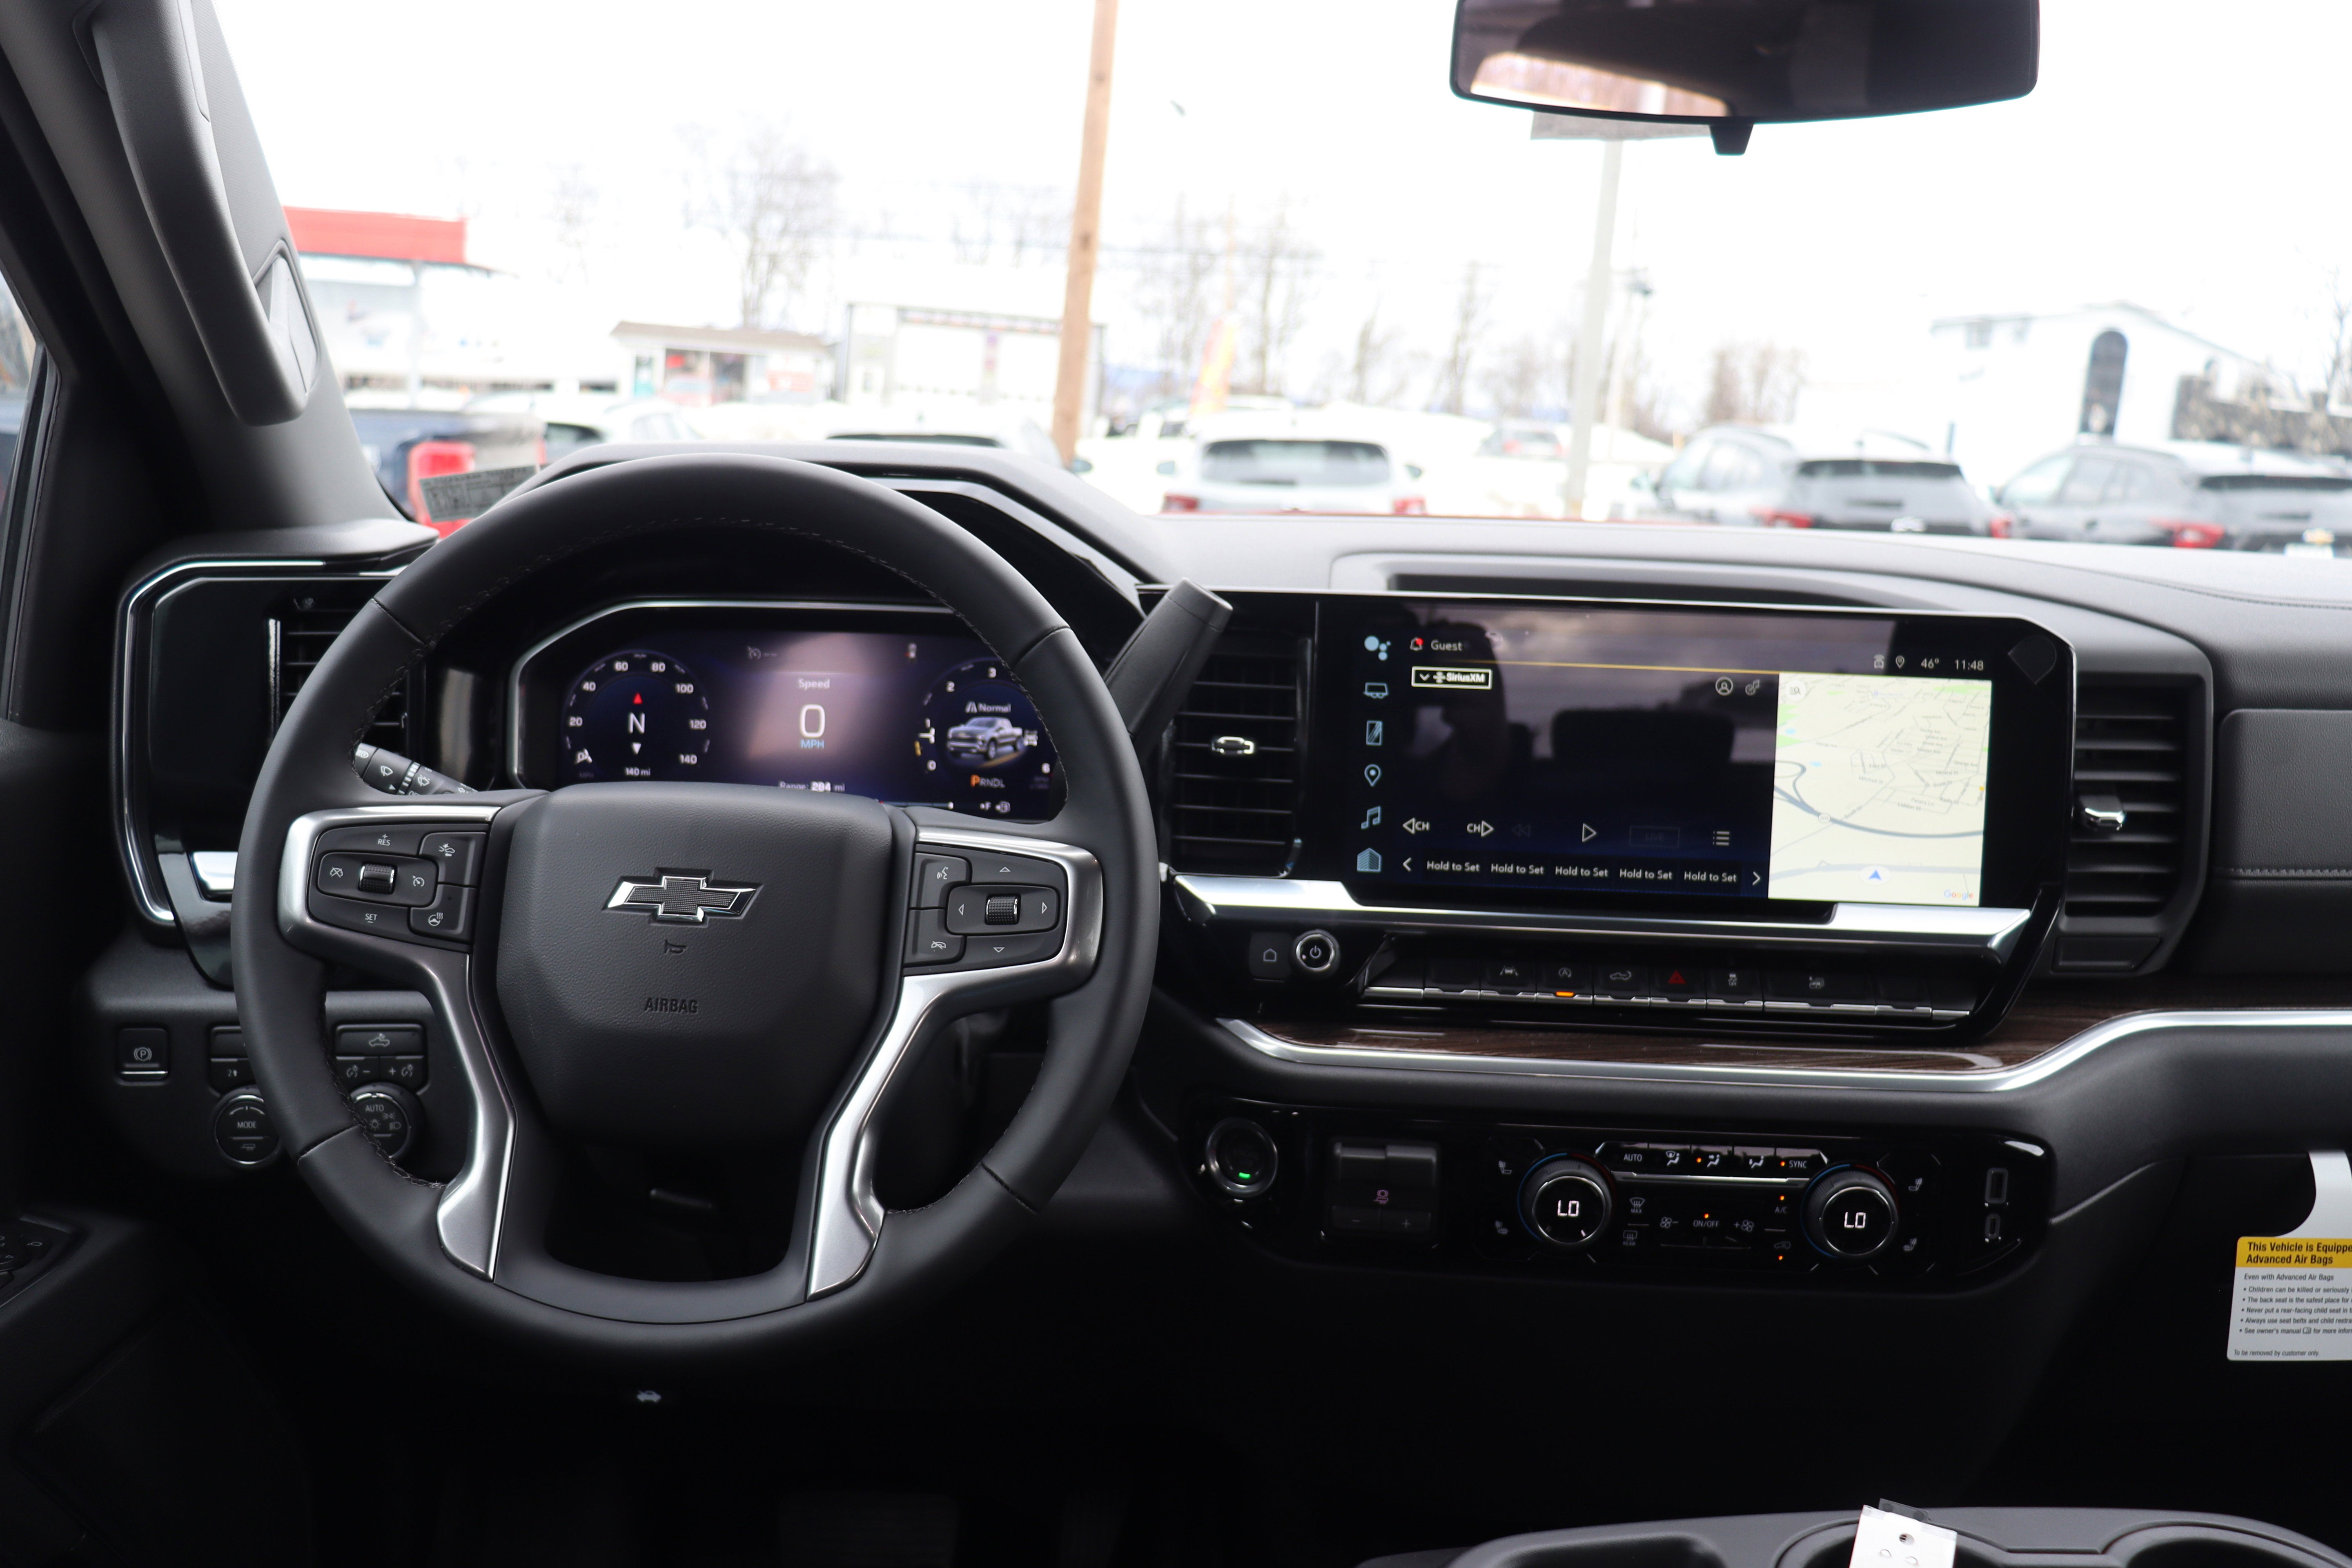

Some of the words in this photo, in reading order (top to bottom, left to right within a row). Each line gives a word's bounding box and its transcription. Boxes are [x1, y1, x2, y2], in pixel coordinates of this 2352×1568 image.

[1430, 640, 1462, 651] Guest
[615, 661, 628, 671] 60
[651, 662, 666, 672] 80
[1955, 659, 1984, 670] 11:48
[988, 667, 996, 678] 3
[1446, 672, 1485, 683] SiriusXM
[583, 682, 596, 691] 40
[676, 684, 694, 694] 100
[798, 679, 830, 691] Speed
[946, 681, 955, 692] 2
[980, 703, 1011, 713] Normal
[569, 717, 583, 727] 20
[628, 713, 645, 733] N
[690, 719, 707, 730] 120
[800, 704, 825, 738] 0
[800, 739, 824, 749] MPH
[679, 754, 697, 765] 140
[927, 760, 936, 771] 0
[1041, 763, 1050, 773] 6
[626, 767, 639, 776] 140
[641, 768, 651, 776] mi
[833, 783, 845, 792] mi
[985, 802, 991, 810] F
[1415, 821, 1430, 831] CH
[1467, 823, 1481, 833] CH
[1427, 861, 1450, 871] Hold
[1452, 862, 1462, 871] to
[1464, 862, 1480, 871] Set
[1491, 863, 1513, 873] Hold
[1516, 865, 1526, 873] to
[1528, 864, 1544, 874] Set
[1555, 866, 1577, 875] Hold
[1580, 867, 1590, 876] to
[1592, 867, 1608, 877] Set
[1619, 869, 1642, 878] Hold
[1644, 870, 1655, 879] to
[1657, 869, 1673, 880] Set
[1684, 871, 1706, 881] Hold
[1709, 873, 1719, 882] to
[1722, 872, 1737, 882] Set
[1944, 889, 1973, 901] Google
[644, 997, 698, 1014] AIRBAG
[365, 1104, 384, 1112] AUTO
[1557, 1200, 1579, 1217] LO
[1844, 1212, 1866, 1229] LO
[2248, 1242, 2267, 1251] This
[2270, 1242, 2303, 1252] Vehicle
[2306, 1243, 2313, 1252] is
[2247, 1254, 2292, 1264] Advanced
[2294, 1255, 2307, 1264] Air
[2310, 1255, 2333, 1266] Bags
